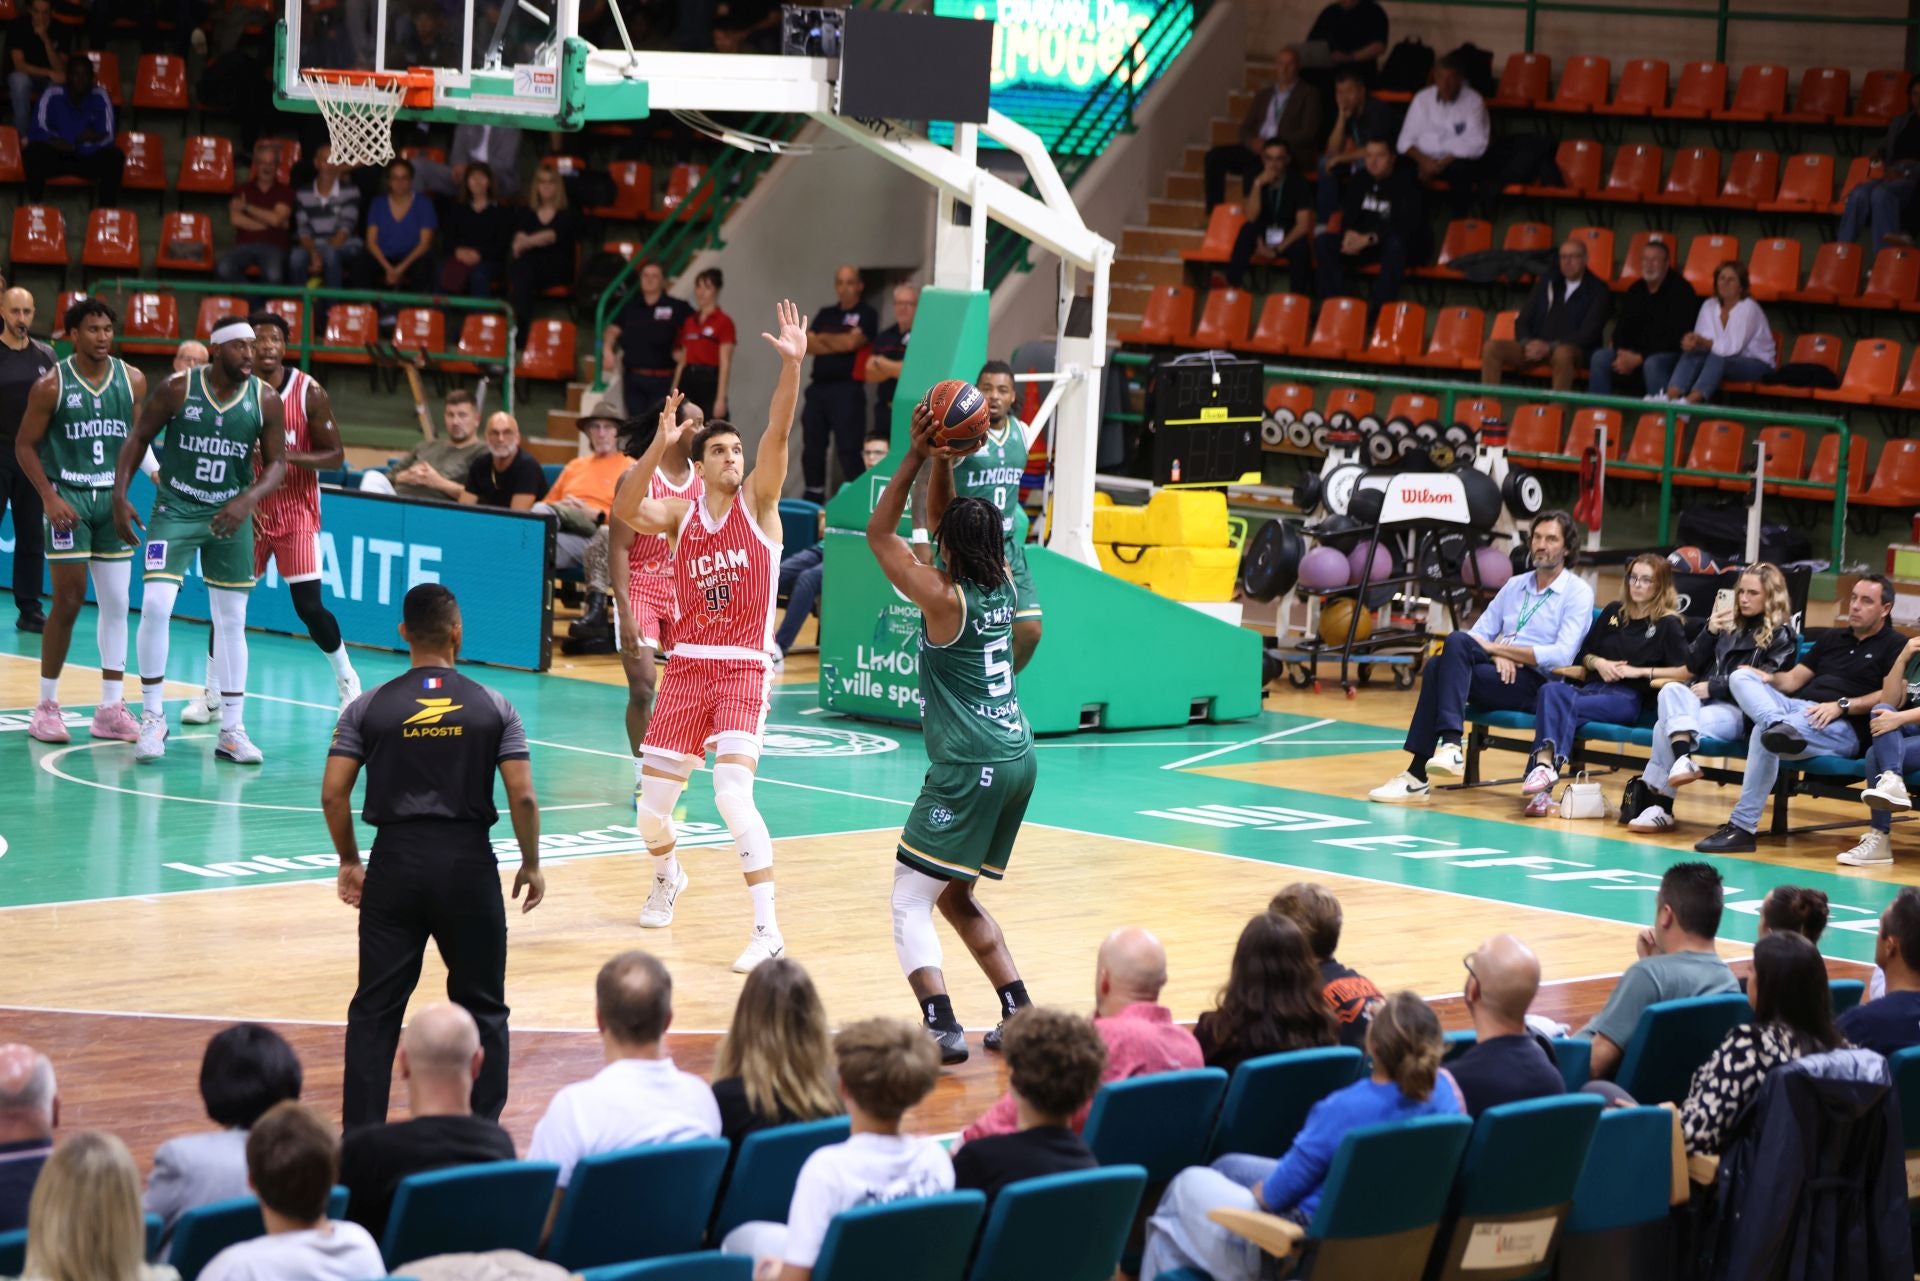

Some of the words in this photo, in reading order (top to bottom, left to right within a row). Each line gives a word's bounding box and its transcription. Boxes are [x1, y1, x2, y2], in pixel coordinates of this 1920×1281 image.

[93, 440, 104, 465] 9
[179, 433, 249, 459] LIMOGES
[195, 458, 227, 484] 20
[967, 467, 1024, 487] LIMOGE
[994, 487, 1006, 510] 0
[1402, 488, 1453, 504] Wilson
[686, 549, 749, 579] UCAM
[697, 571, 740, 589] MURCIA
[706, 585, 731, 611] 99
[972, 606, 1013, 635] LEWIS
[984, 636, 1012, 697] 5
[842, 671, 883, 698] ville
[888, 685, 921, 708] spo
[403, 728, 420, 738] LA
[421, 726, 463, 737] POSTE
[980, 767, 994, 787] 5
[932, 808, 951, 822] CSP
